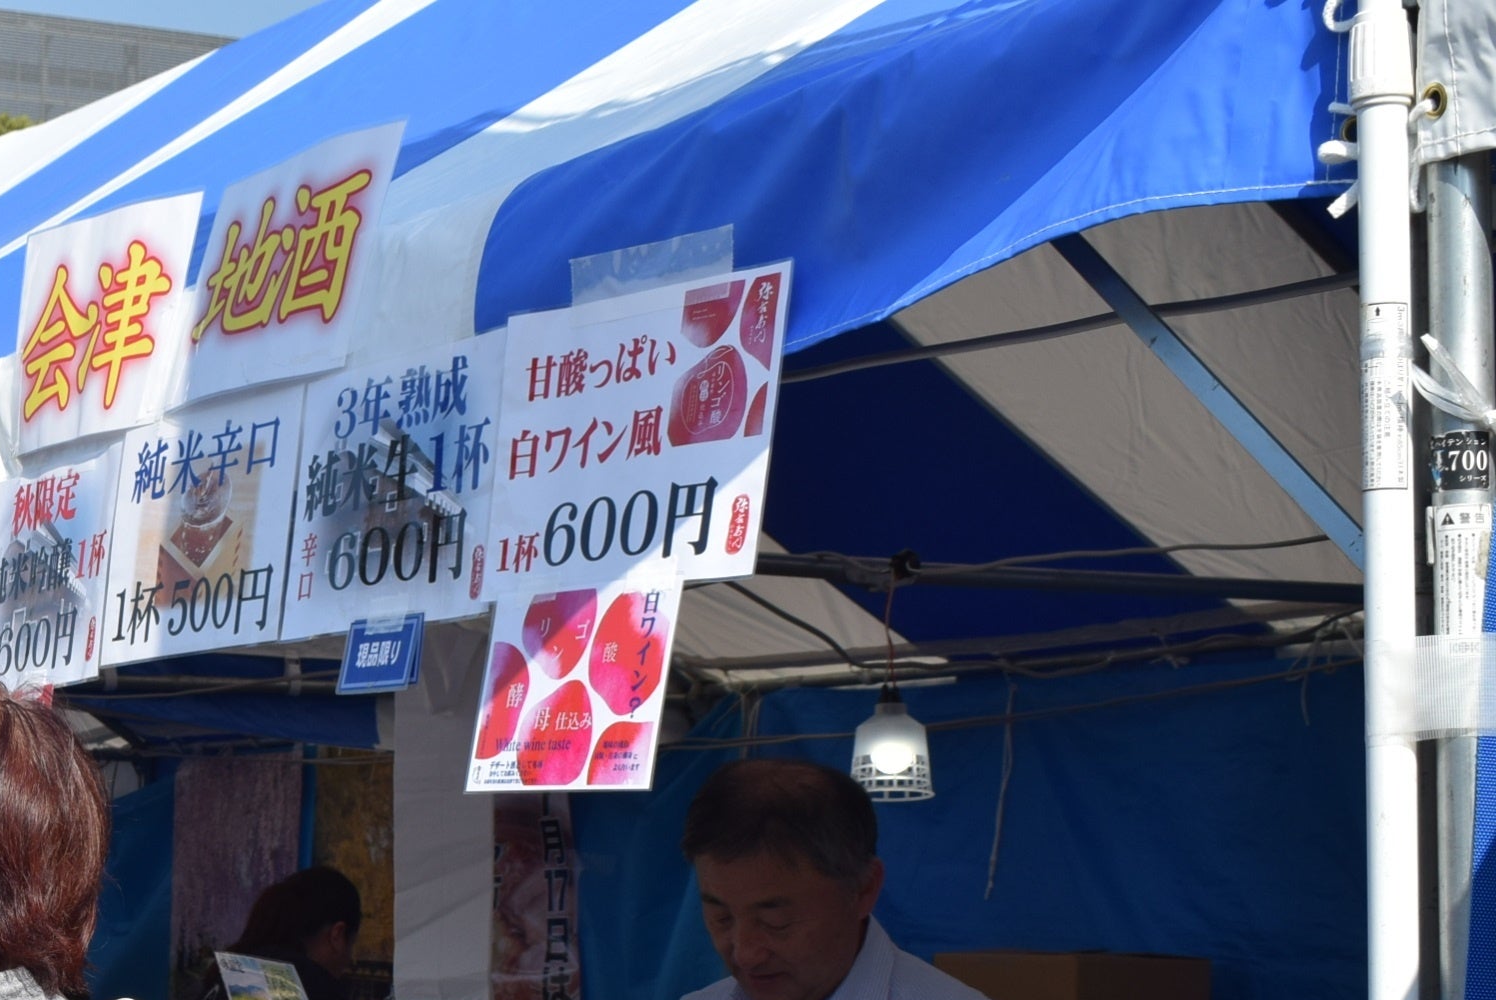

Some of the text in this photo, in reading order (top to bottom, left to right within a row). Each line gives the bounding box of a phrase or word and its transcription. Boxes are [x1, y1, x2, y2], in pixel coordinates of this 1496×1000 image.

[21, 168, 373, 423] 会津 地酒
[334, 354, 469, 440] 3年熟成
[525, 334, 677, 403] 甘酸っぱい
[131, 416, 281, 505] 純米辛口
[304, 417, 492, 523] 純米生 1杯
[508, 405, 664, 481] 白ワイン風
[11, 467, 81, 537] 秋限定
[496, 475, 719, 574] 1杯 600円
[74, 528, 108, 579] 1杯
[297, 531, 318, 602] 辛口
[327, 507, 468, 592] 600円
[111, 563, 275, 647] 1杯 500円
[355, 639, 402, 669] 現品限り
[628, 590, 660, 719] 白ワイン?
[495, 738, 572, 752] White wine taste
[554, 712, 593, 731] 仕込み
